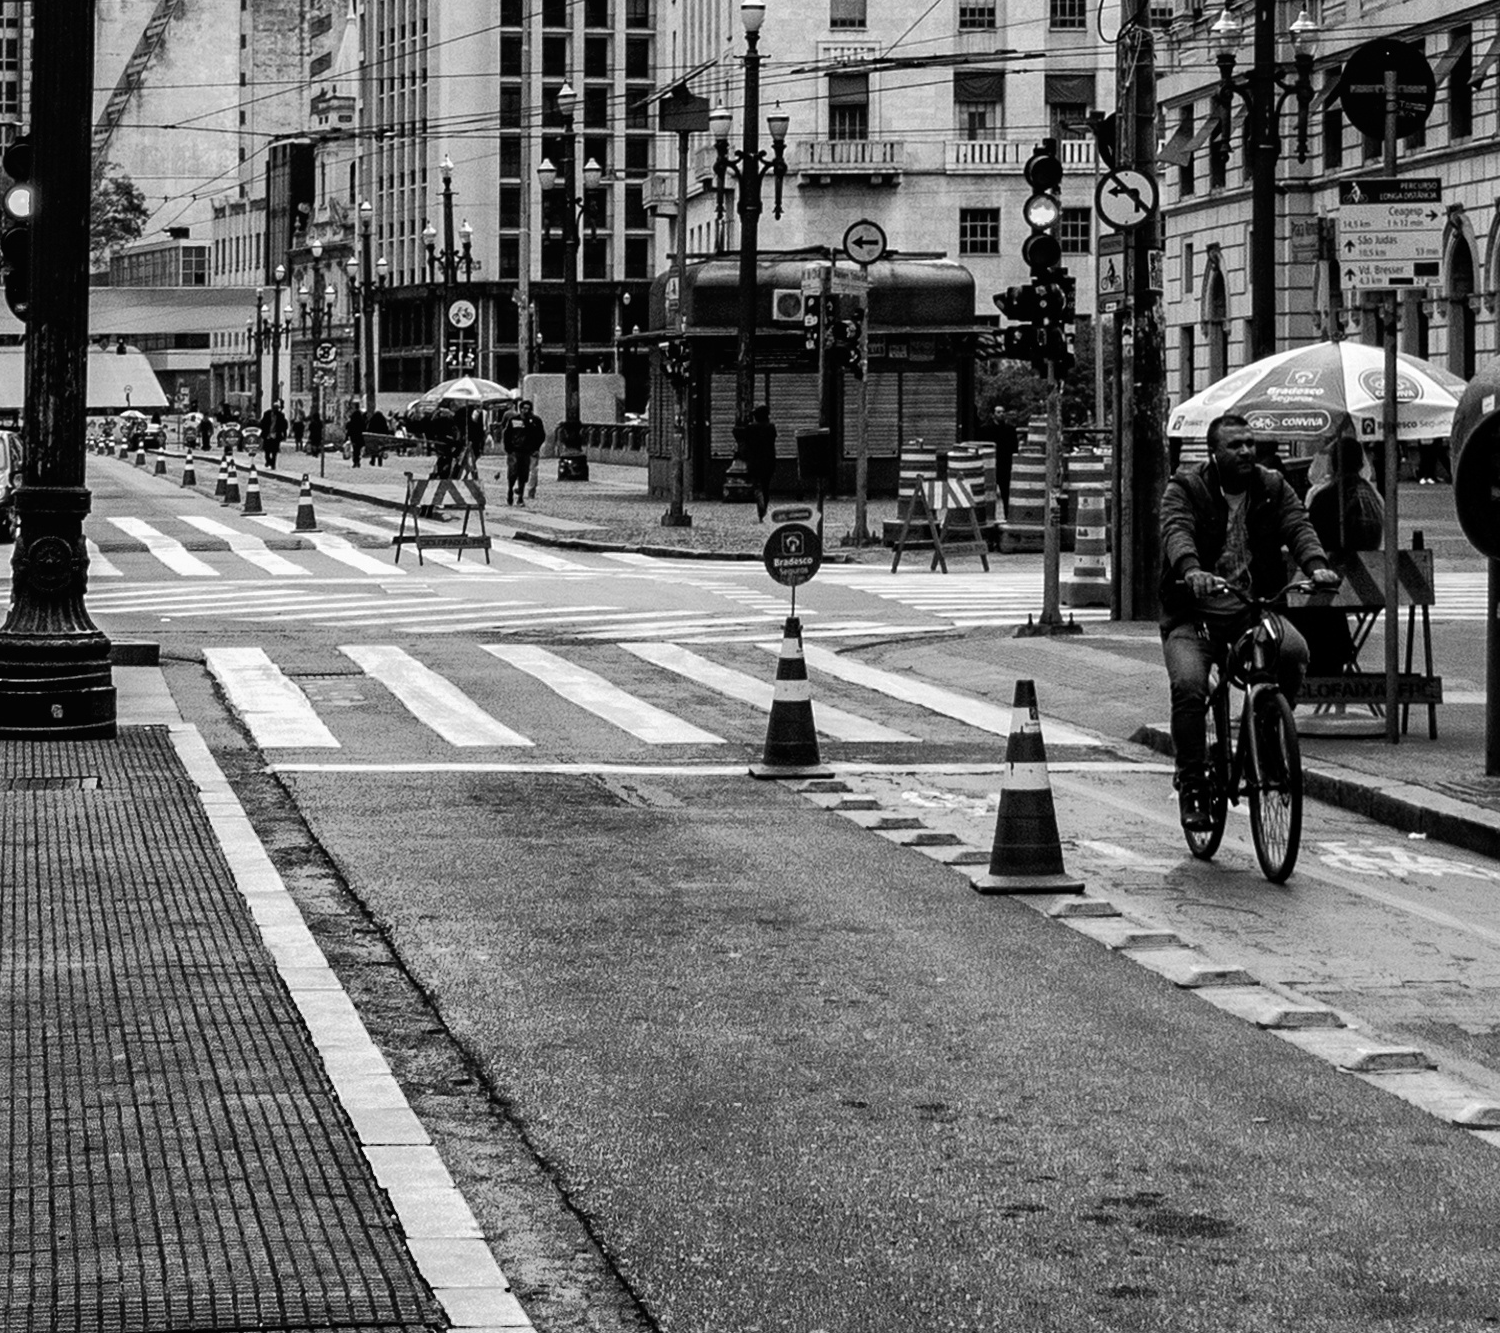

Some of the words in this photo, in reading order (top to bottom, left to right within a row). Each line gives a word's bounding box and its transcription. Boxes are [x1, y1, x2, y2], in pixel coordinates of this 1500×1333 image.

[1400, 181, 1438, 190] PERCURSO
[1379, 192, 1403, 201] LONGA
[1388, 206, 1424, 218] Ceagesp
[1360, 220, 1371, 228] km
[1357, 235, 1373, 245] São
[1375, 235, 1398, 245] Judas
[1375, 248, 1387, 257] km
[1373, 265, 1404, 275] Bresser
[1266, 387, 1325, 396] Bradesco
[1282, 417, 1324, 426] CONVIVA
[773, 556, 814, 567] Bradesco
